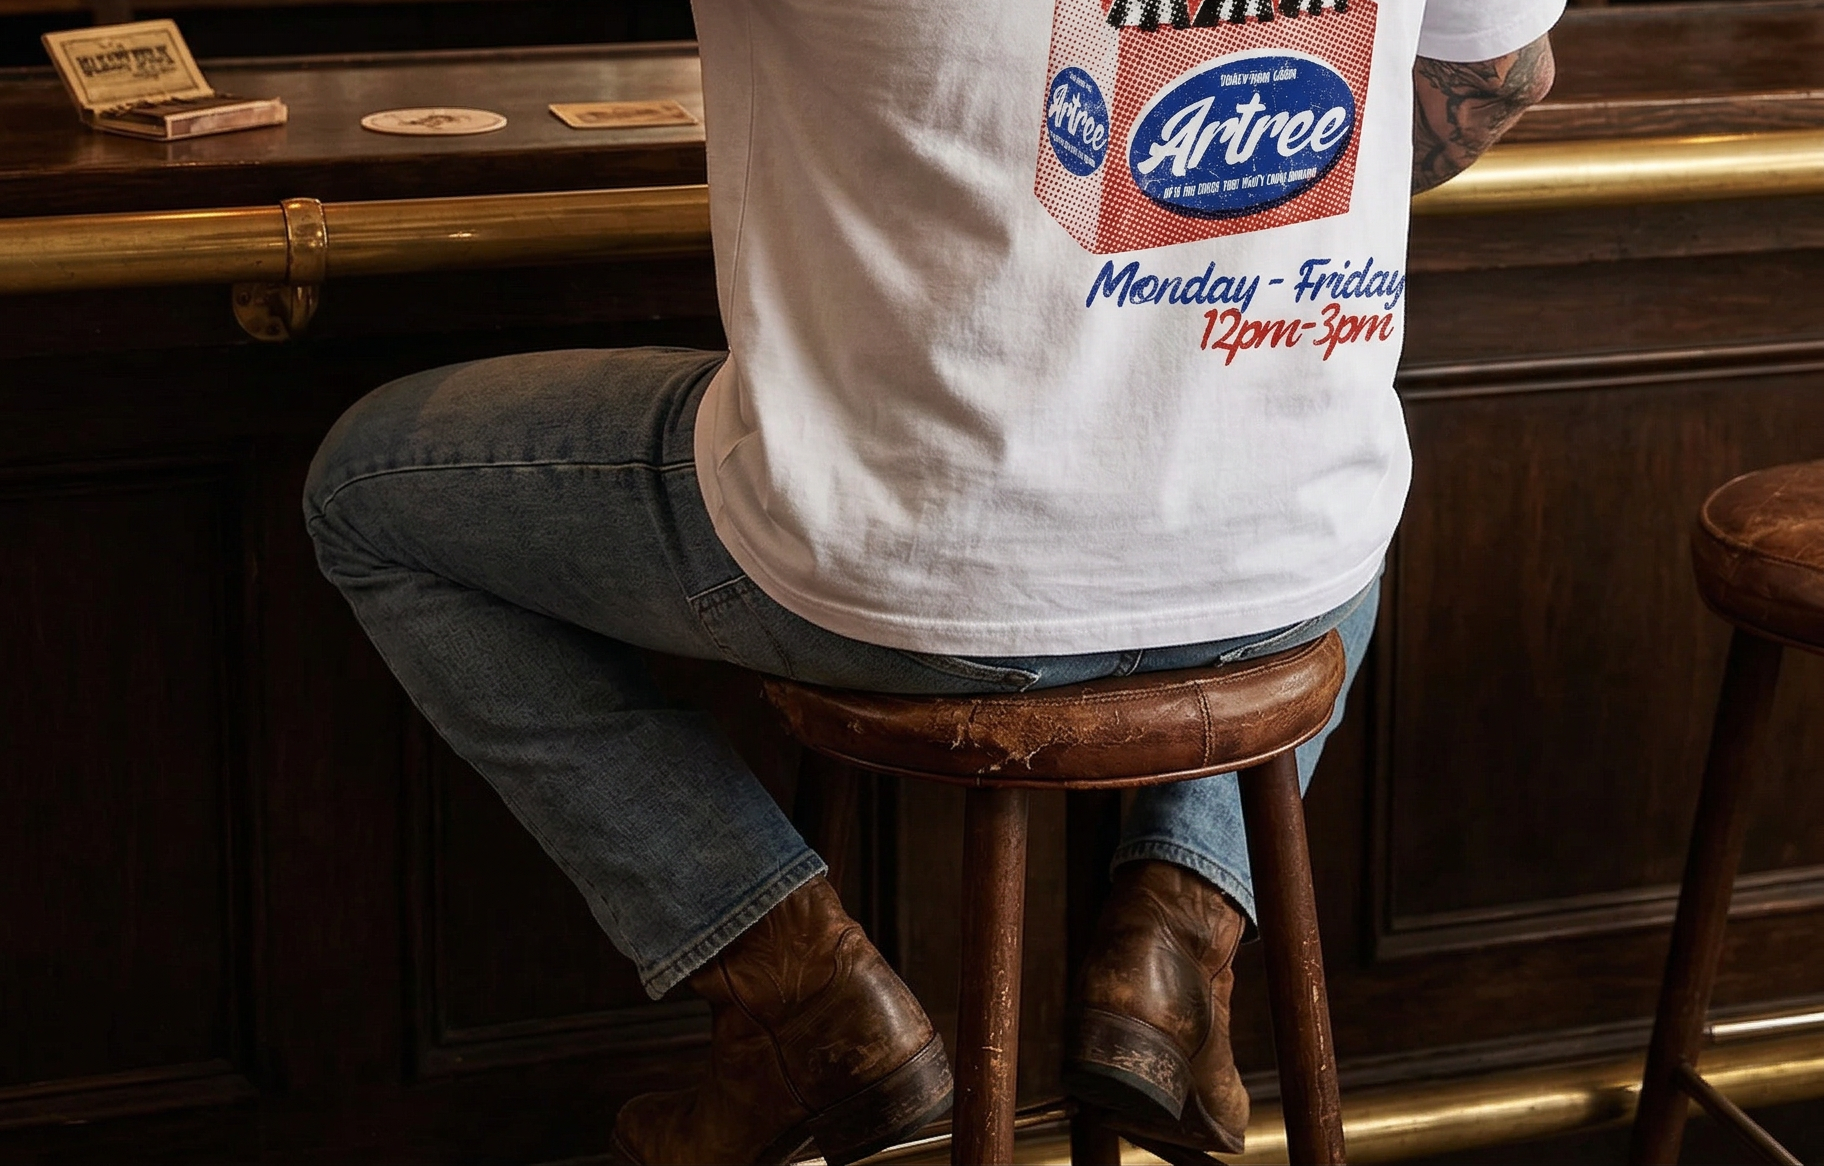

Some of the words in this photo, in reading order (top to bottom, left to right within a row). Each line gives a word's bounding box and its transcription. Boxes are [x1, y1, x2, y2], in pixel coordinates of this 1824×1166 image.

[1048, 83, 1108, 151] Artree
[1137, 92, 1350, 177] Artree
[1086, 260, 1260, 313] Monday
[1294, 257, 1405, 310] Friday
[1200, 303, 1394, 366] 12pm-3pm
